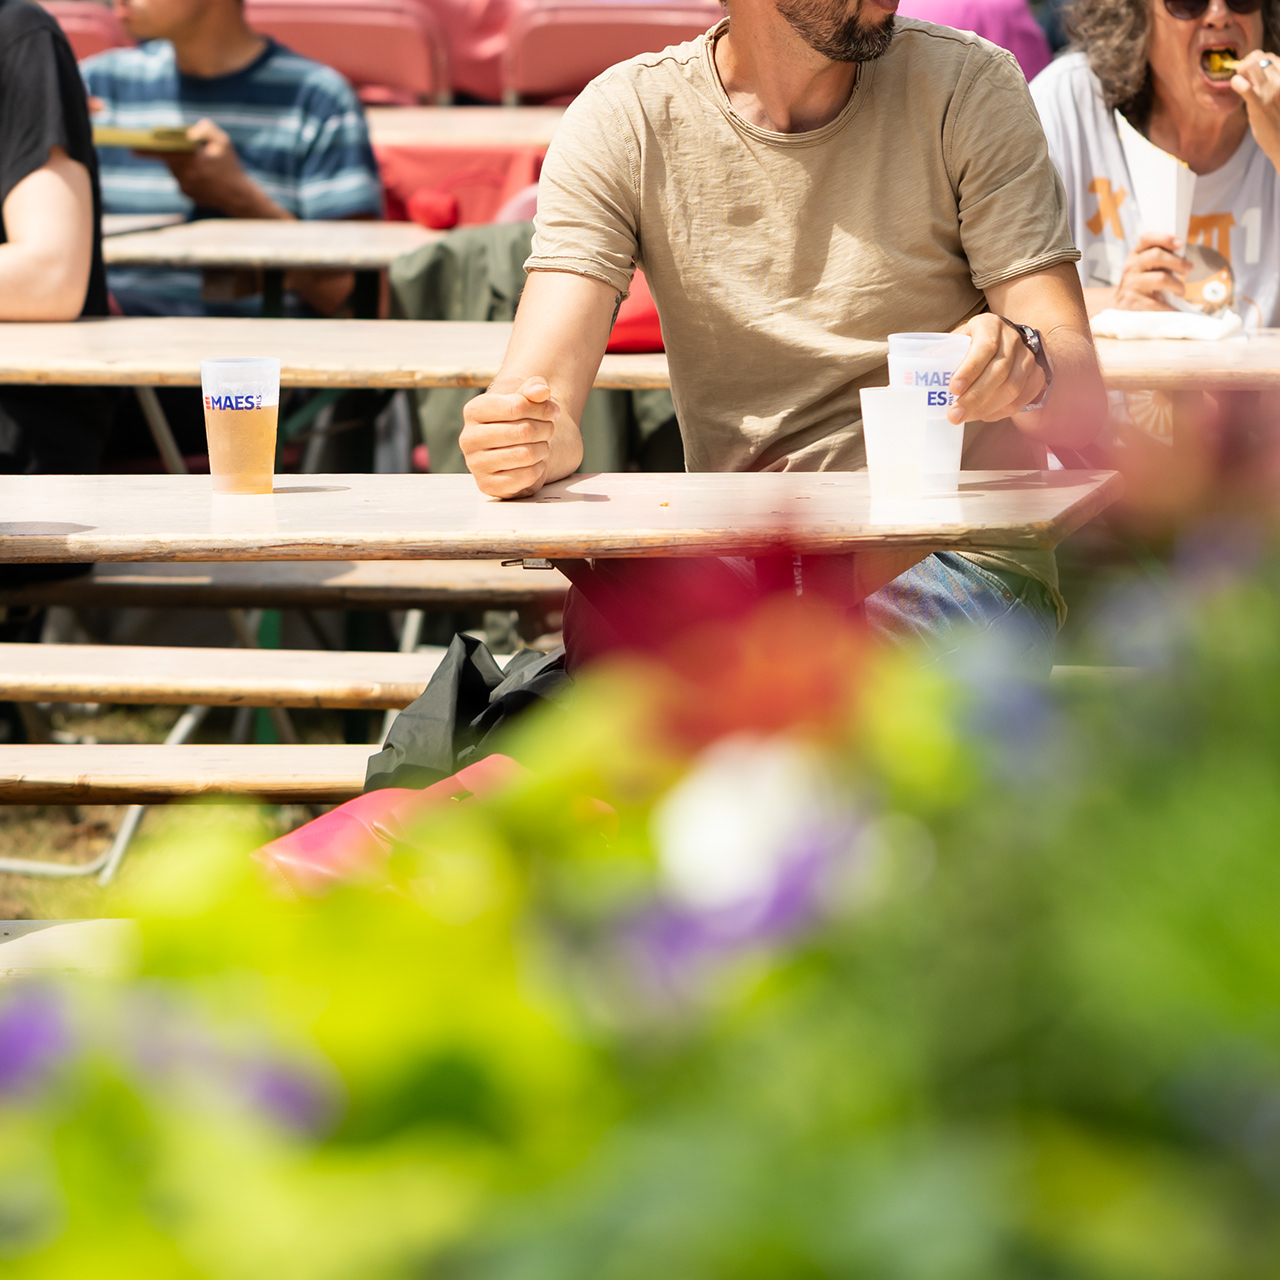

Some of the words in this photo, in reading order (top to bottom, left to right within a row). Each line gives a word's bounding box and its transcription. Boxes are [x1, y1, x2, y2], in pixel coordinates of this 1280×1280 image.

[914, 371, 953, 387] MAE
[211, 395, 255, 410] MAES
[927, 391, 948, 406] ES
